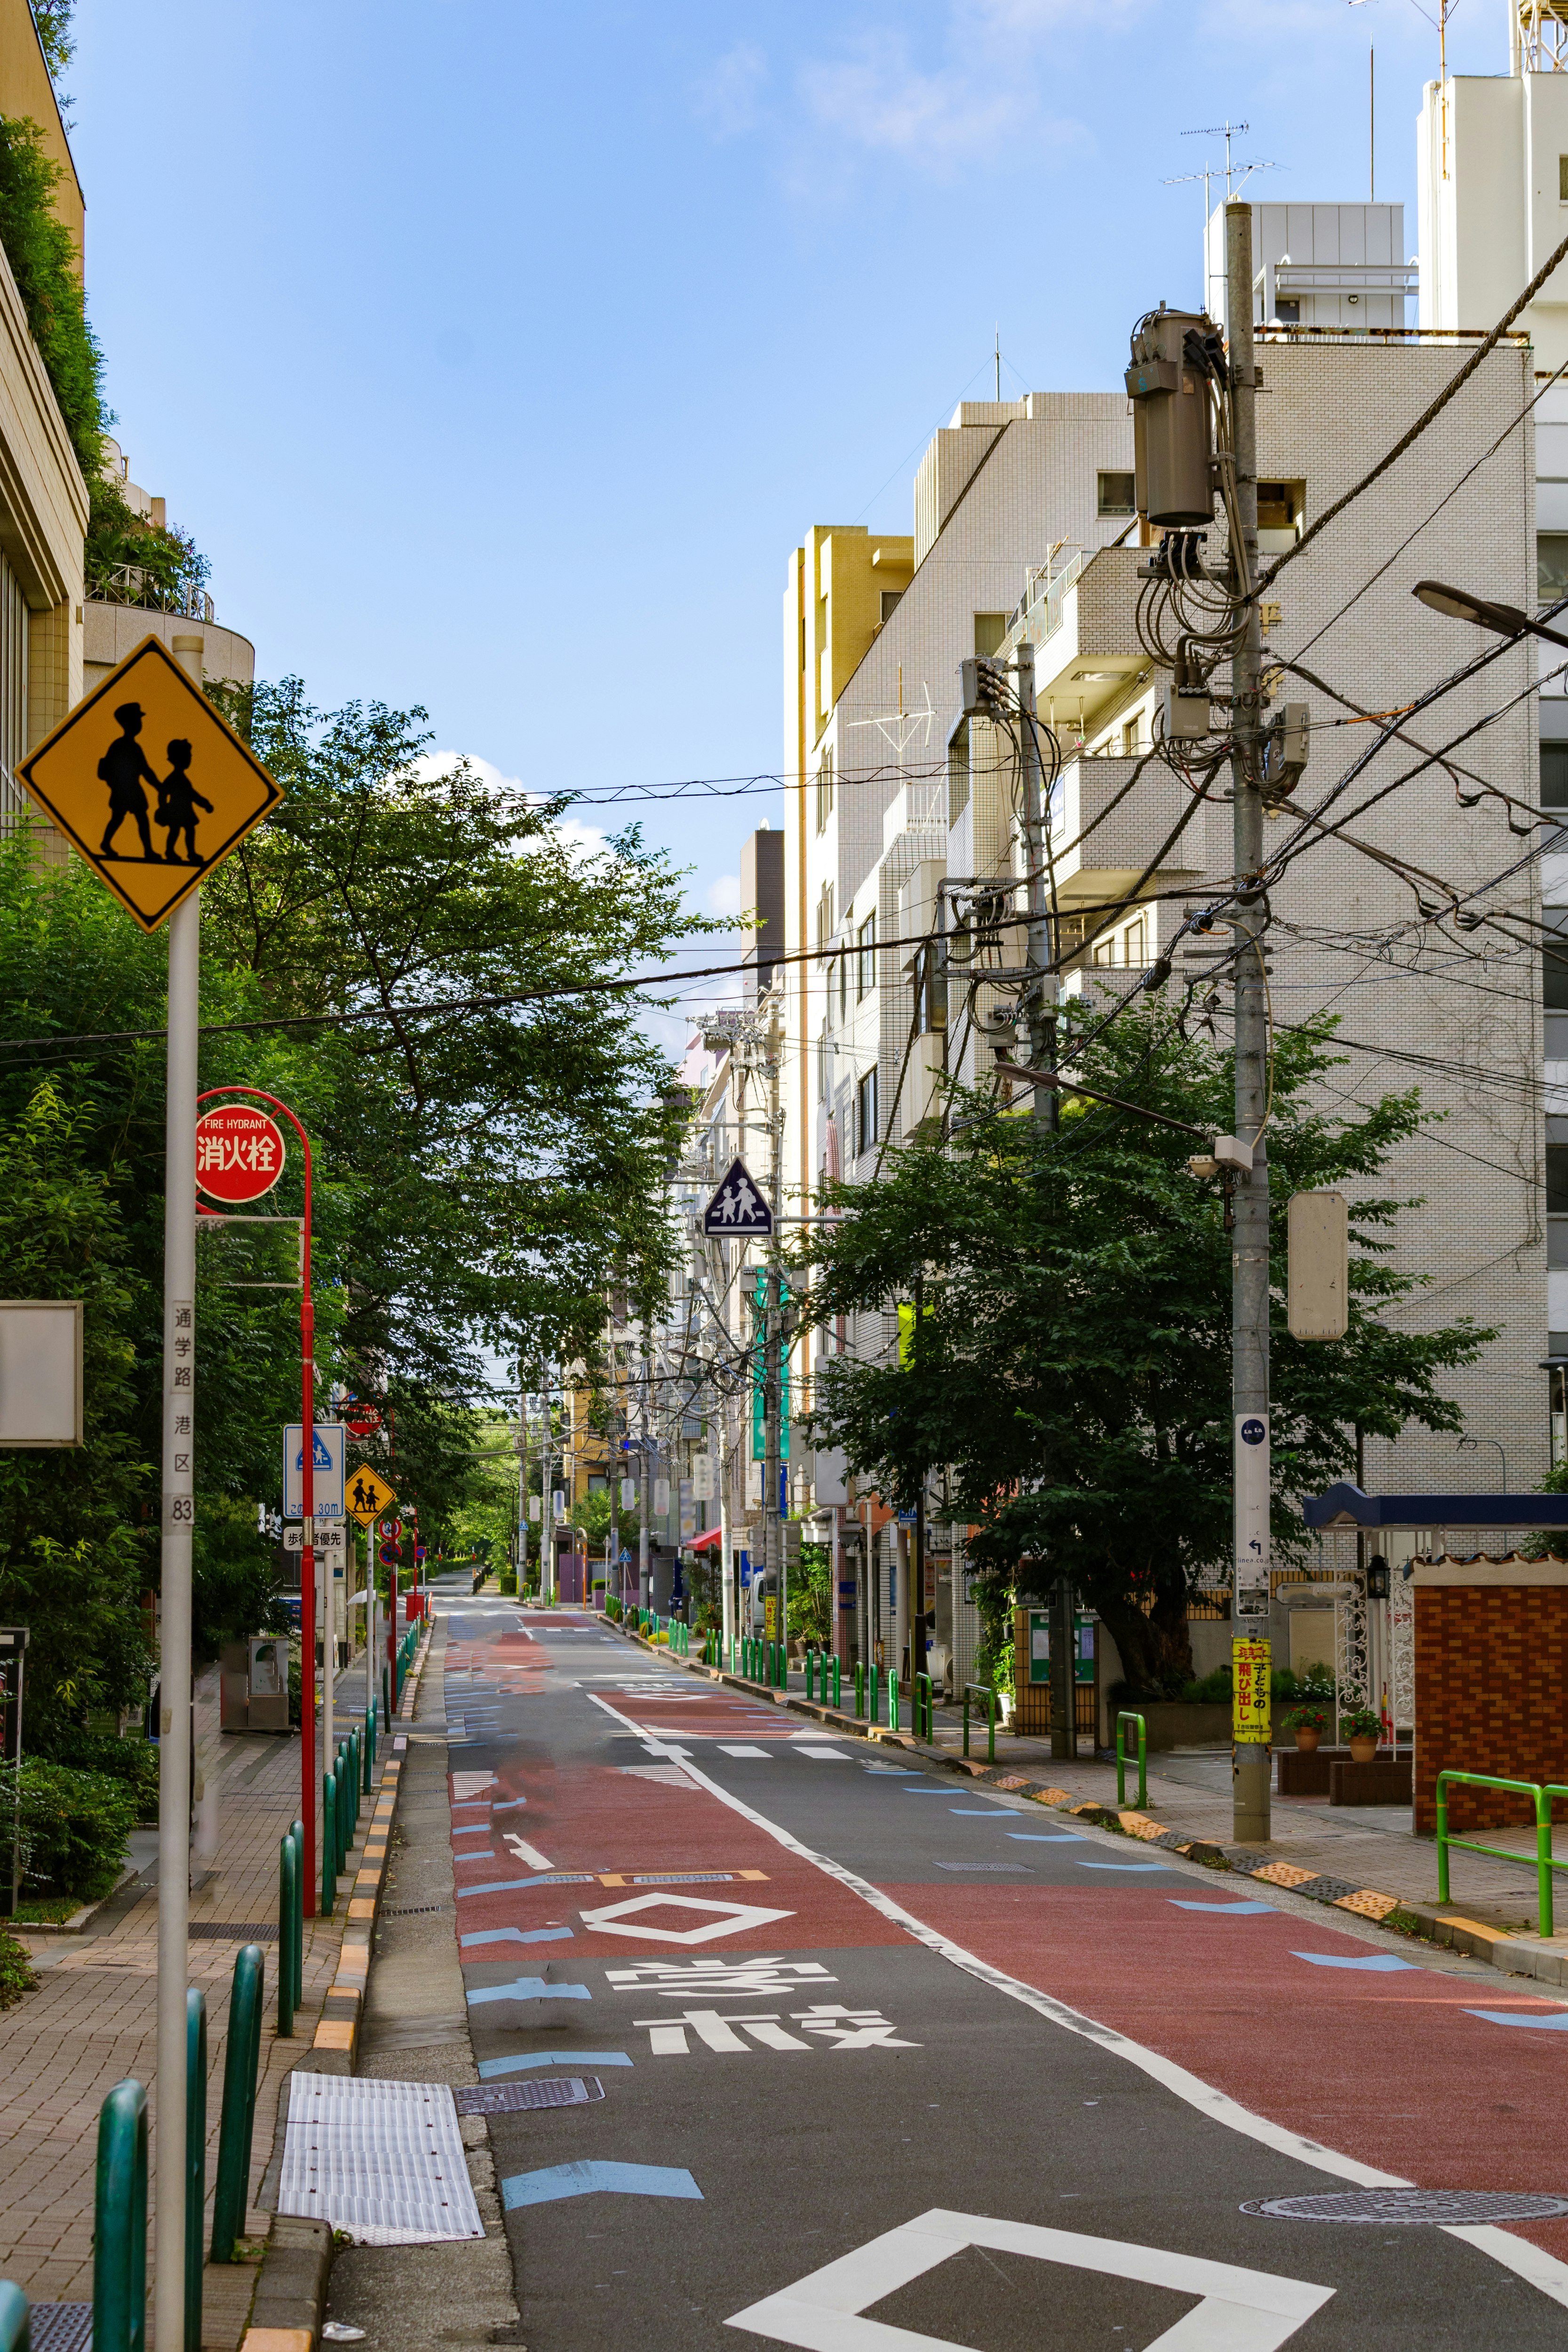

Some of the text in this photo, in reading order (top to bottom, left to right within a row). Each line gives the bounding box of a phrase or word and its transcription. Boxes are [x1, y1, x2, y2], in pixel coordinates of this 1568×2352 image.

[1138, 378, 1147, 392] S
[205, 1119, 267, 1129] FIRE HYDRANT
[198, 1136, 276, 1171] 消火栓
[173, 1309, 191, 1520] 通学路 港区 83
[318, 1503, 338, 1514] 30m
[1238, 1663, 1252, 1721] 飛び出し
[1253, 1664, 1266, 1709] 子どもの
